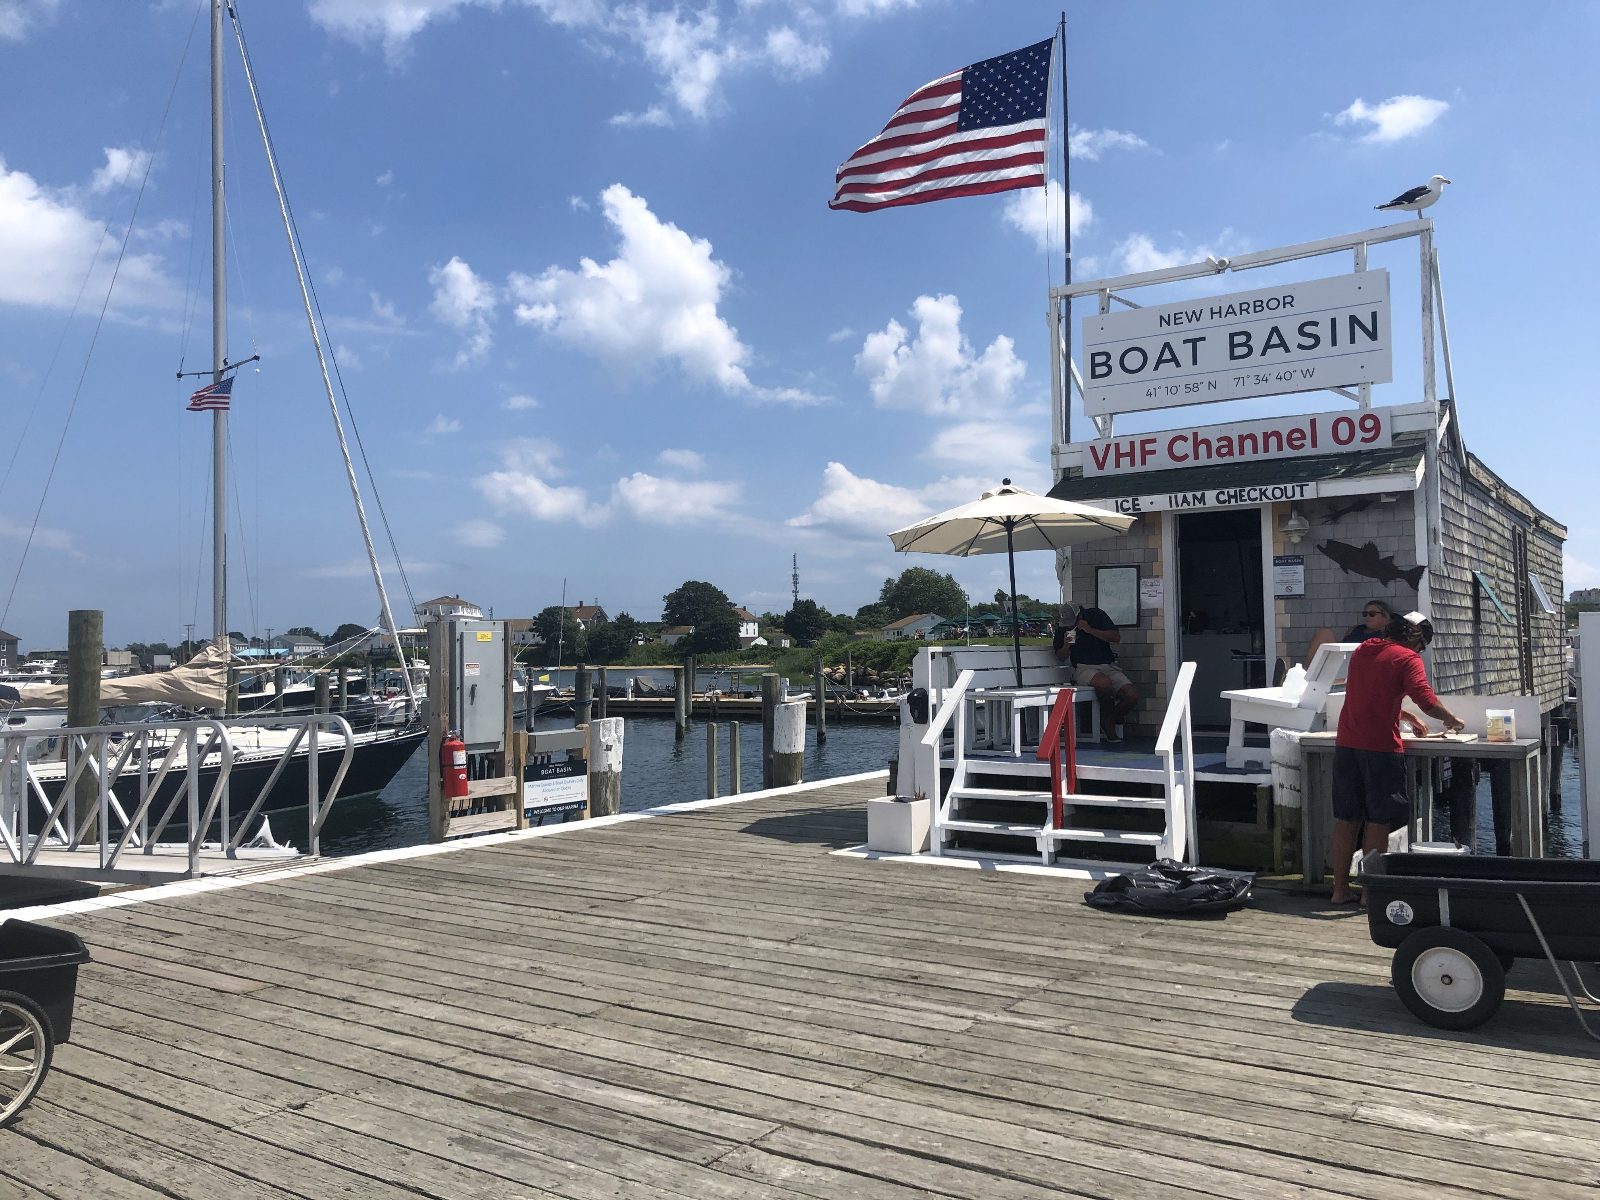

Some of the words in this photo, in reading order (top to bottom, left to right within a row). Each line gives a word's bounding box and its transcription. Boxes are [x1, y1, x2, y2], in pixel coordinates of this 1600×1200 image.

[1159, 309, 1203, 327] NEW
[1210, 295, 1295, 320] HARBOR
[1090, 336, 1206, 380] BOAT
[1228, 310, 1379, 361] BASIN
[1207, 380, 1217, 391] N
[1300, 367, 1316, 379] W
[1089, 437, 1157, 471] VHF
[1167, 417, 1318, 463] Channel
[1331, 413, 1382, 447] 09
[1114, 497, 1141, 514] ICE
[1168, 491, 1206, 509] 11AM
[1215, 483, 1310, 505] CHECKOUT
